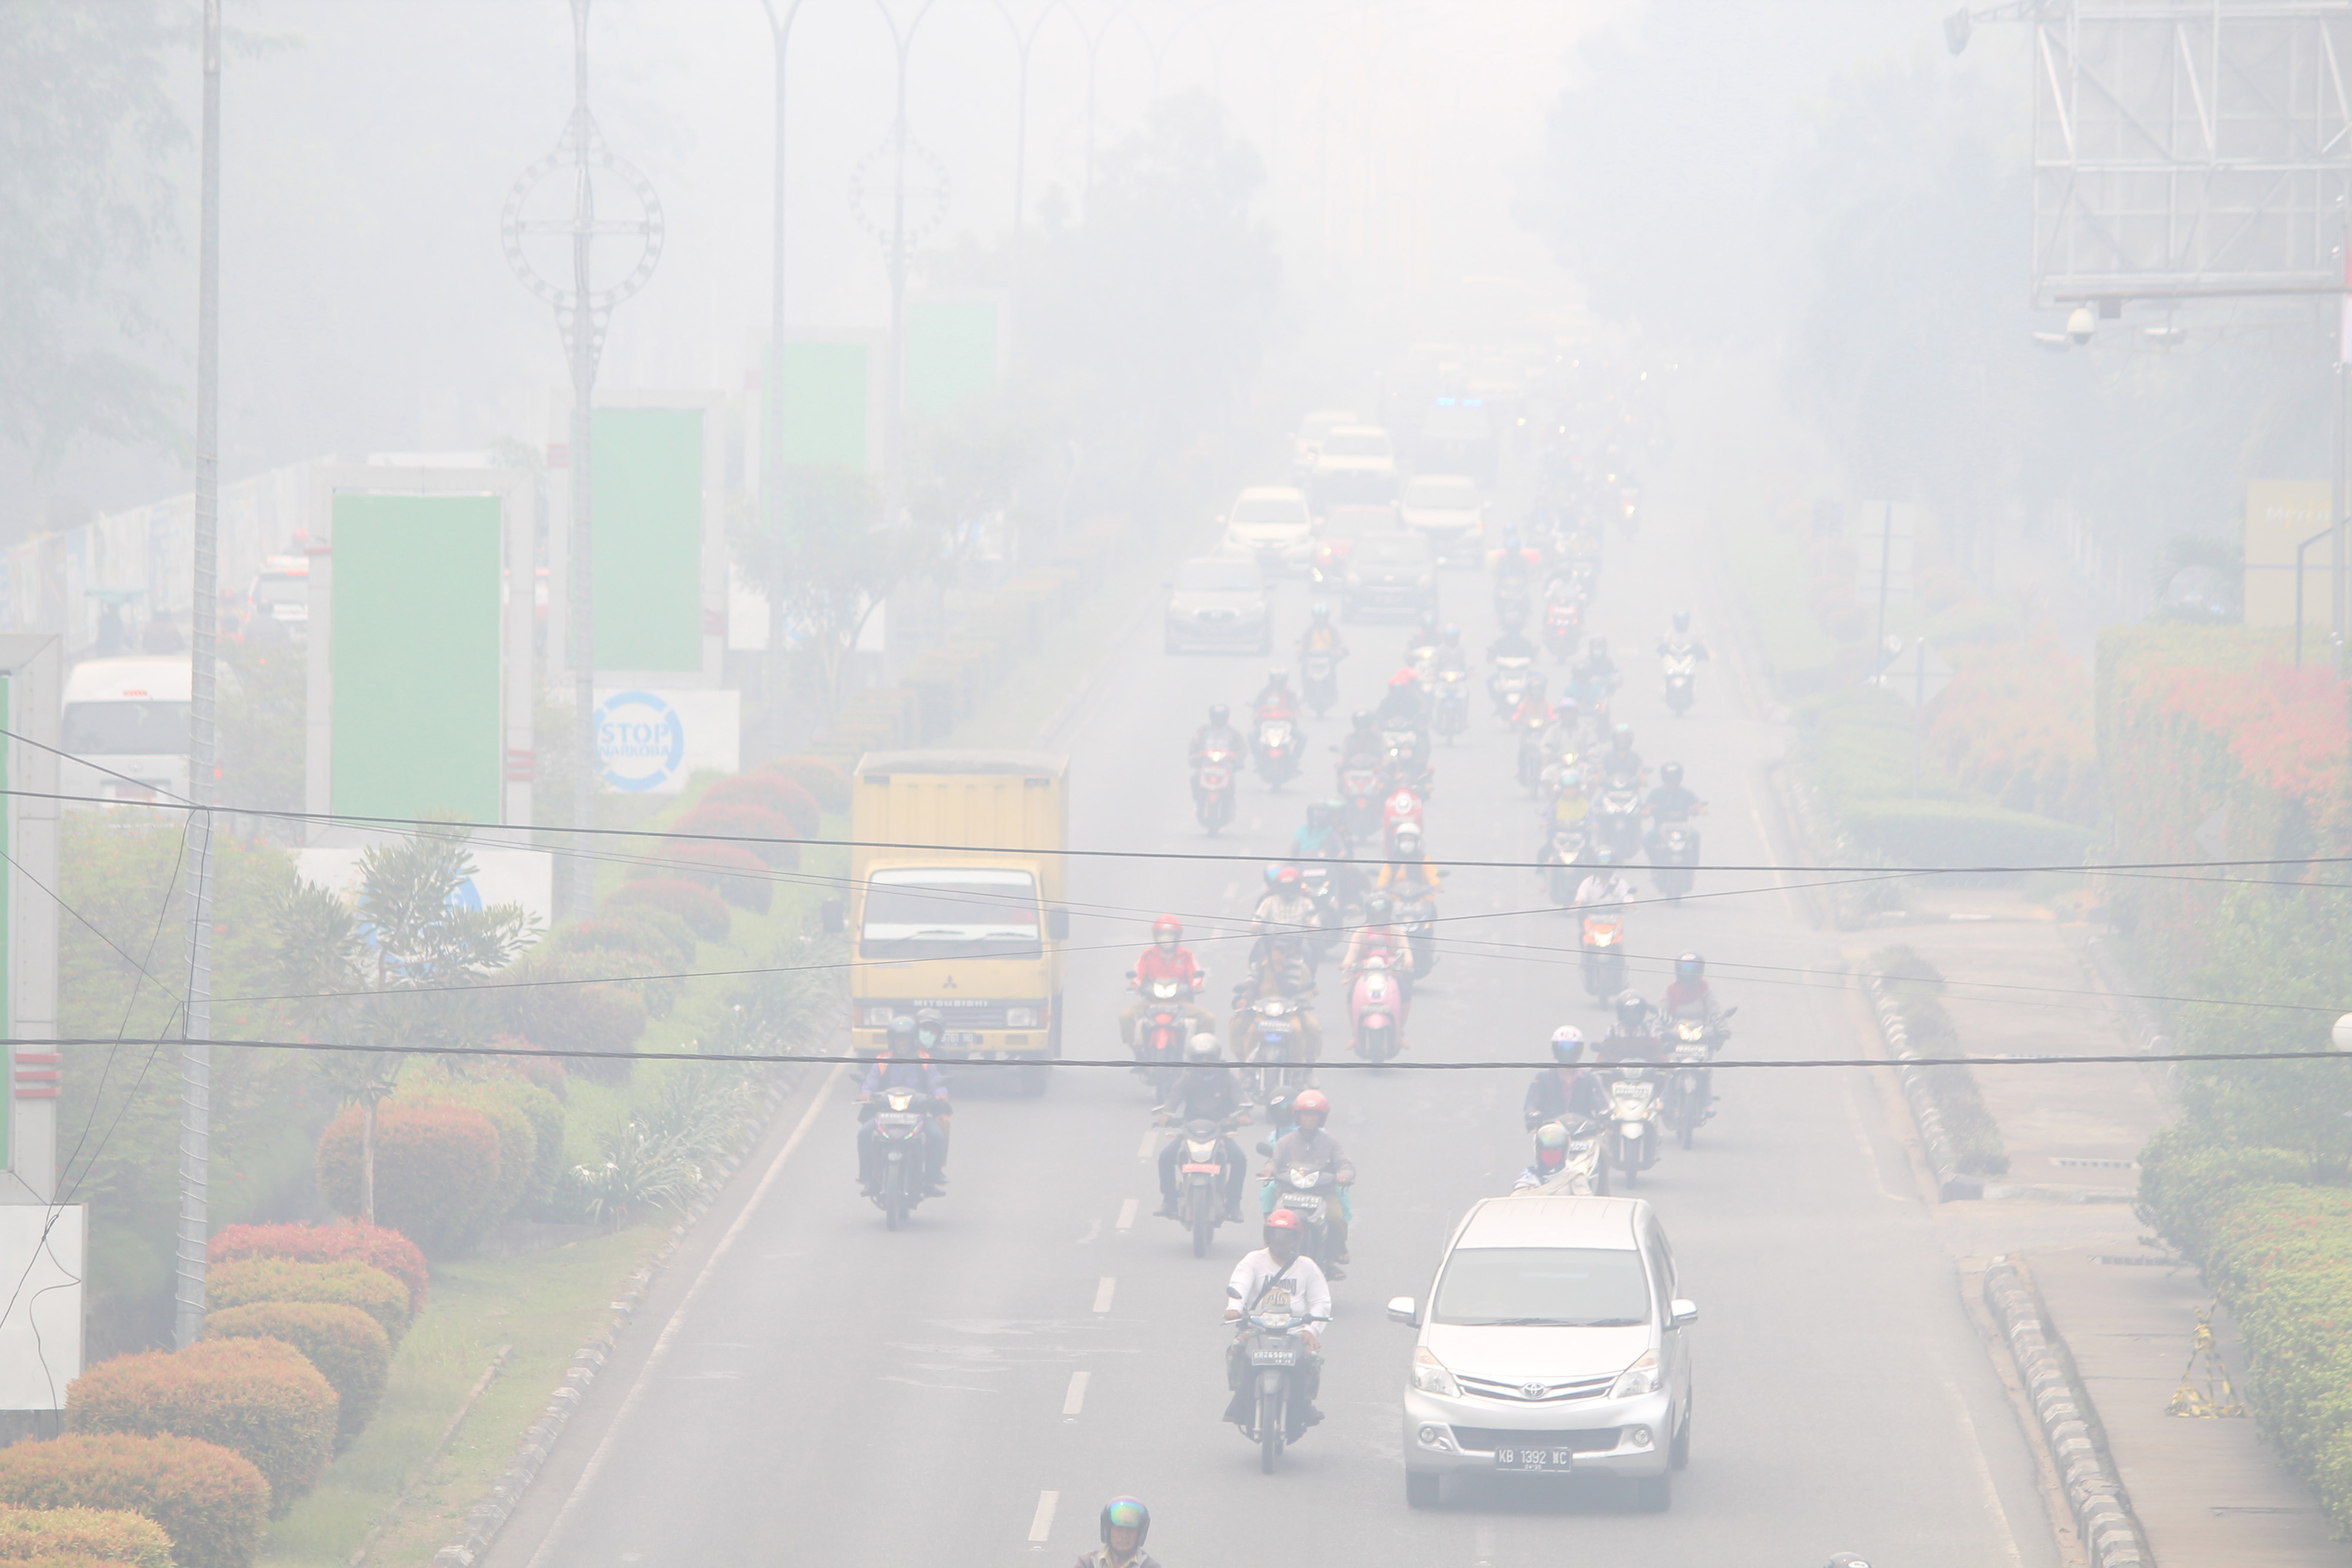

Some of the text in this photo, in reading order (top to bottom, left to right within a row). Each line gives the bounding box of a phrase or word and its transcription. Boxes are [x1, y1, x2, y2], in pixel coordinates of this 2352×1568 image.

[601, 723, 669, 743] STOP
[598, 744, 669, 757] NARKOBA
[1499, 1450, 1567, 1465] KB 1392 WC
